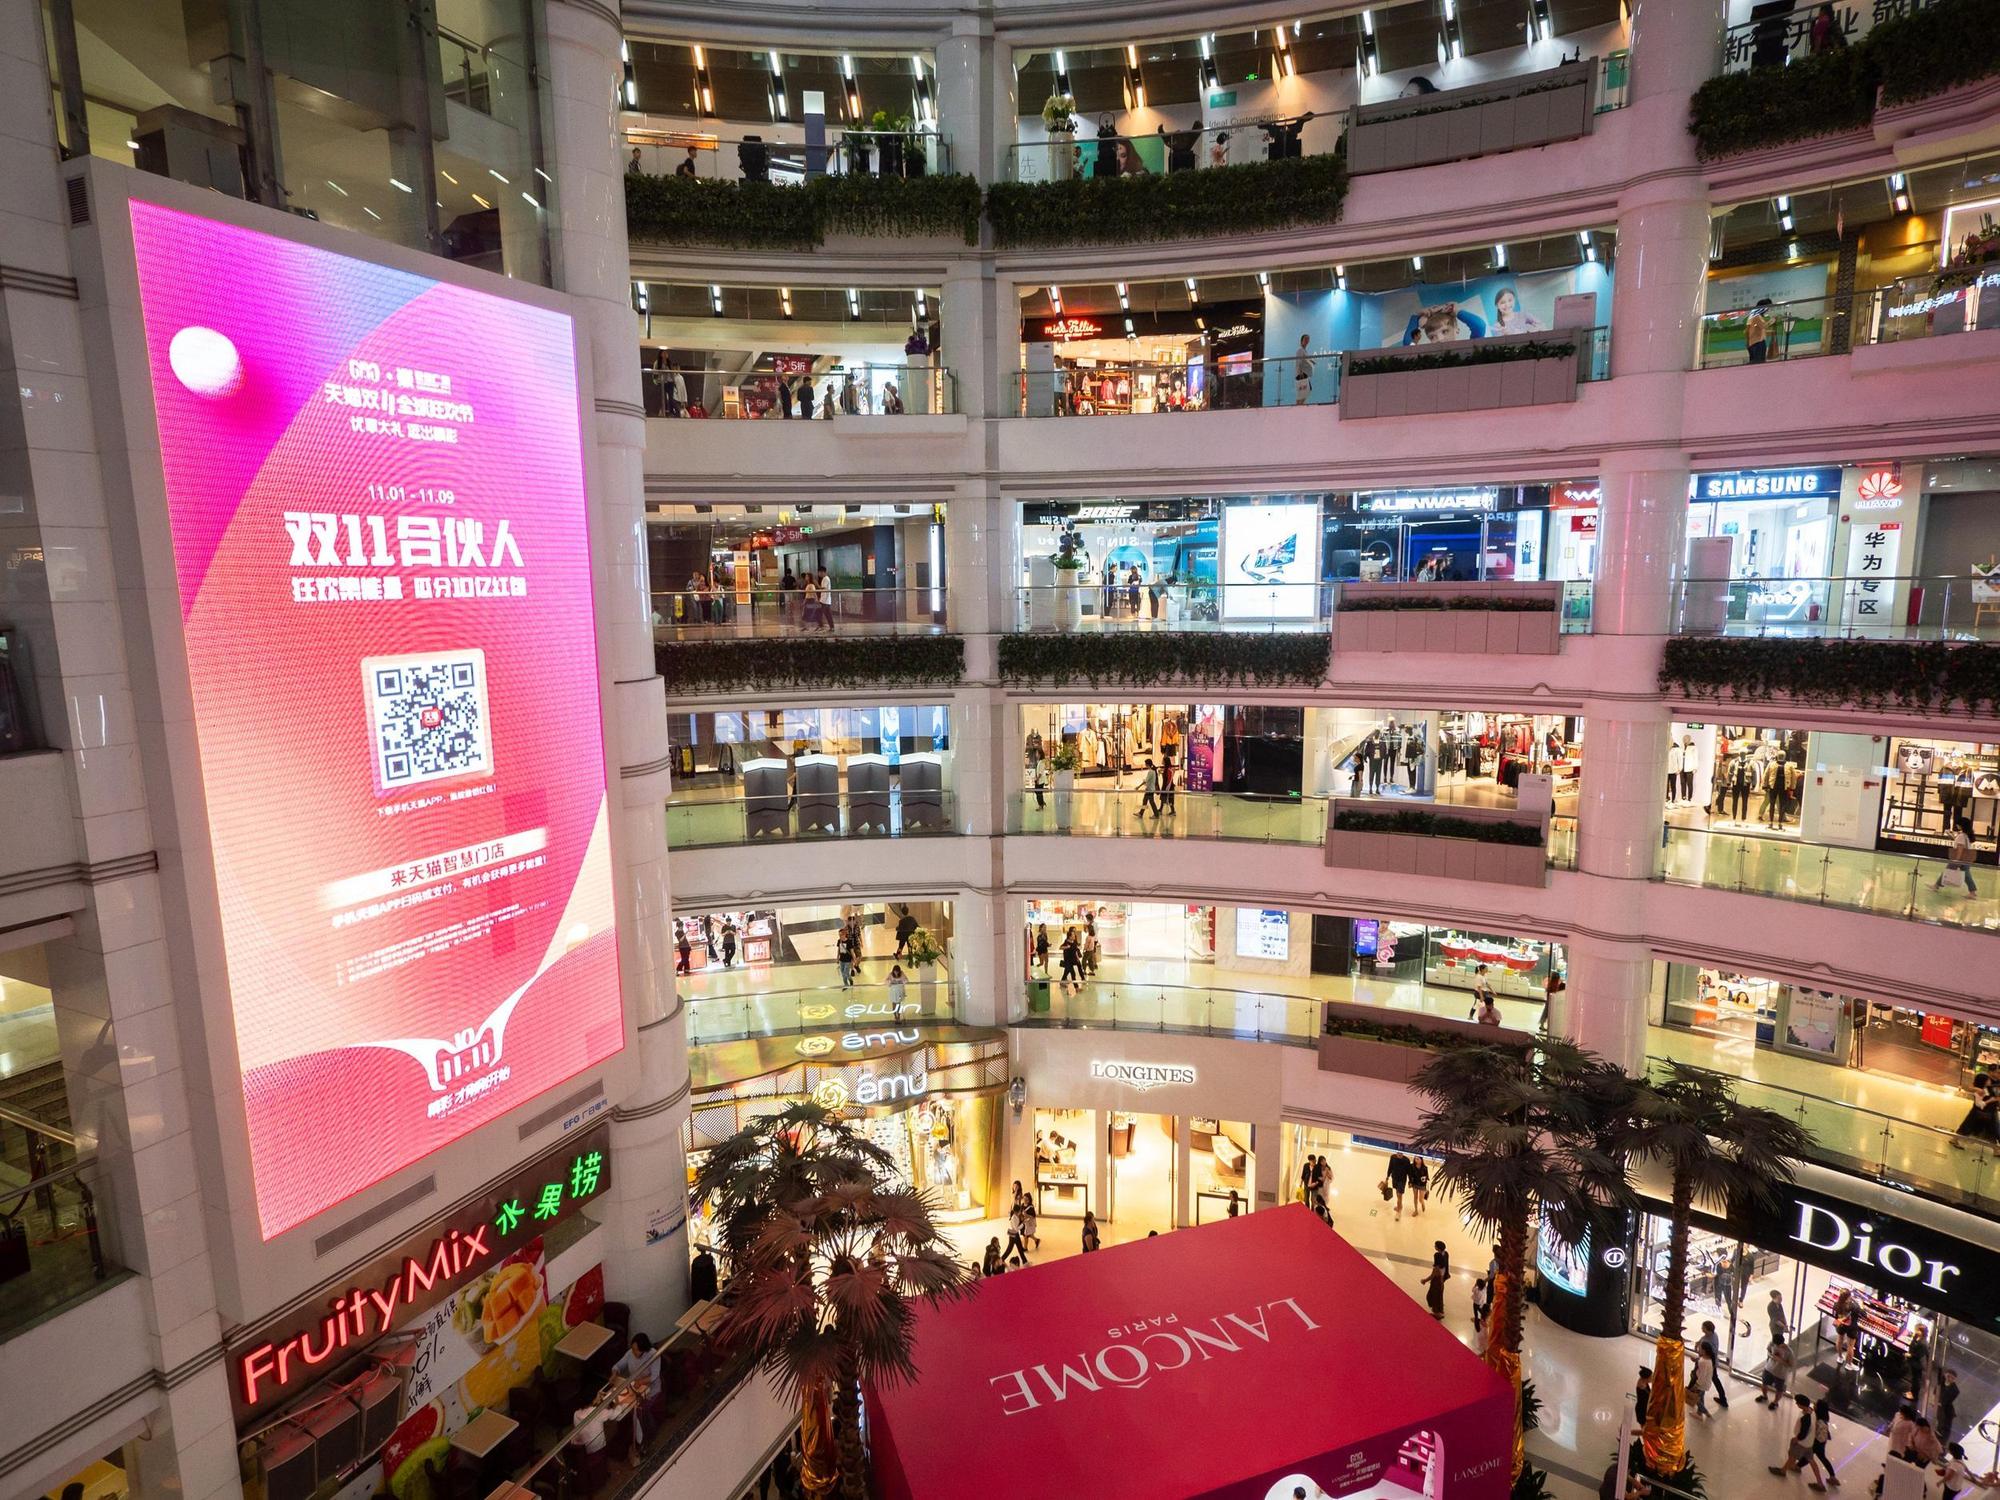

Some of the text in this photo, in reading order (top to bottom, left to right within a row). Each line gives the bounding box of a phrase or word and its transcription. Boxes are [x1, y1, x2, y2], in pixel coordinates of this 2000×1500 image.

[1371, 496, 1482, 511] ALIENWARE
[1708, 475, 1818, 496] SAMSUNG
[1069, 506, 1140, 519] BOSE
[283, 511, 525, 567] 双11合伙人
[1858, 531, 1886, 615] 华为专区
[391, 843, 505, 887] 来天猫智慧门店
[442, 1041, 491, 1082] 11.11
[1092, 1063, 1194, 1084] LONGINES
[563, 1114, 581, 1131] EFG
[1788, 1199, 1961, 1294] Dior
[243, 1151, 602, 1406] FruityMix 水果捞
[1107, 1312, 1178, 1339] PARIS
[989, 1297, 1322, 1416] LANCÔME
